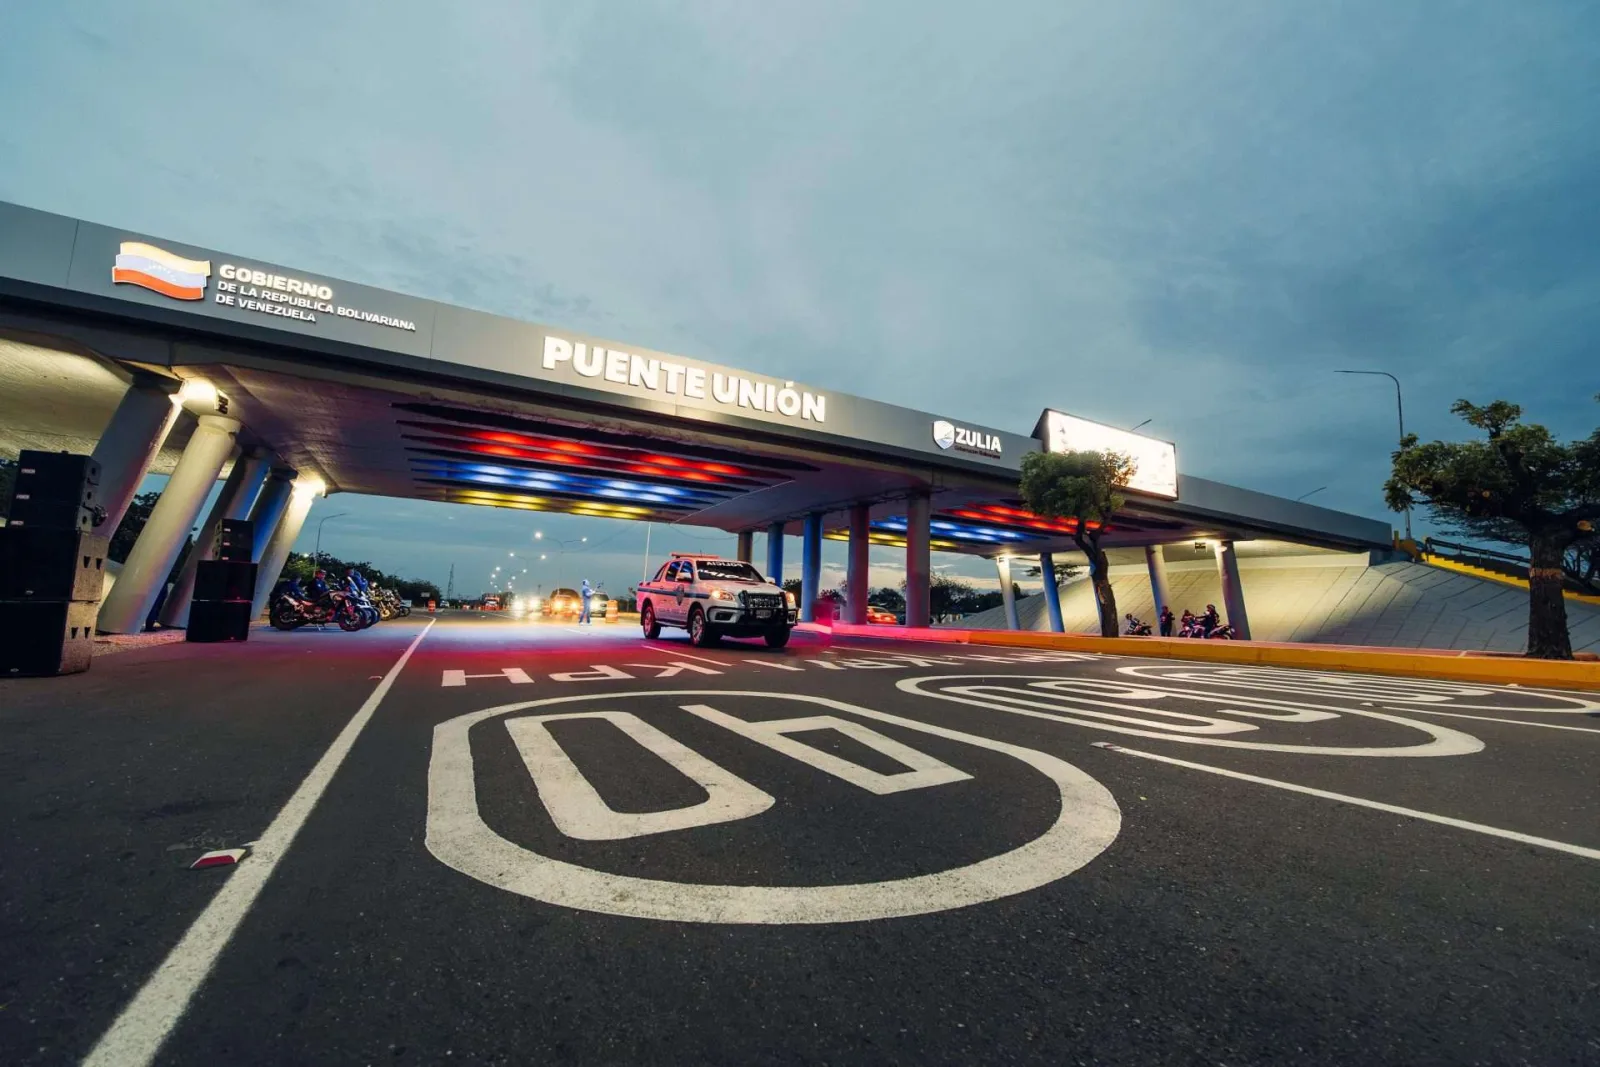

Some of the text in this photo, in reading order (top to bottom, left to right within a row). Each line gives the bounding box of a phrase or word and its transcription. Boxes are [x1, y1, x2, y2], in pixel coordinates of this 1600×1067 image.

[219, 263, 334, 301] GOBIERNO
[215, 292, 317, 323] DE VENEZUELA
[217, 280, 416, 332] DE LA REPUBLICA BOLIVARIANA
[542, 335, 826, 423] PUENTE UNIÓN
[955, 427, 1002, 453] ZULIA
[440, 661, 725, 687] KPH
[504, 703, 974, 842] 40
